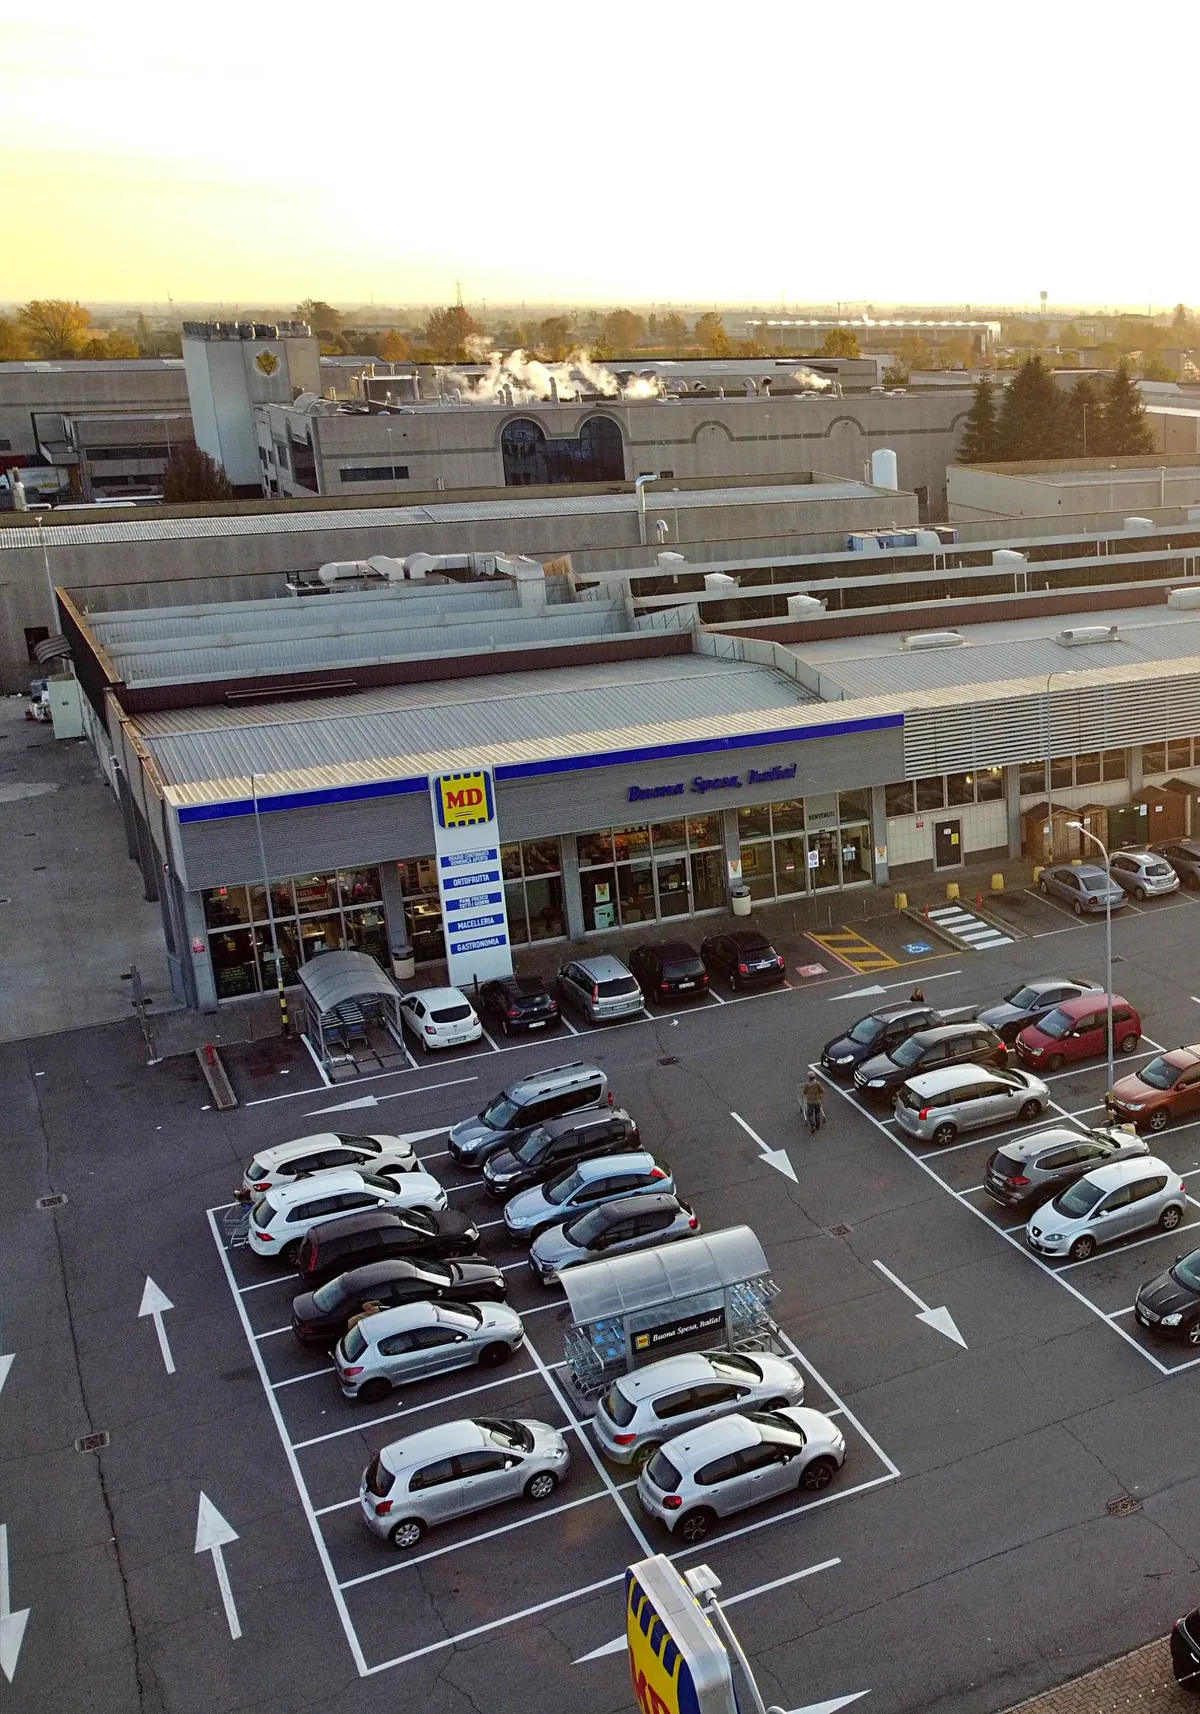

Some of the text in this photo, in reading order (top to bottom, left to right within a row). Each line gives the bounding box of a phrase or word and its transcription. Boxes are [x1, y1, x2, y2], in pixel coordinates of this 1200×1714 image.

[445, 787, 483, 810] MD
[453, 874, 490, 887] ORTOFRUTTA
[457, 917, 495, 930] MACELLERIA
[457, 938, 500, 952] GASTRONOMIA
[653, 1315, 722, 1342] Buona Spesa, Italia!
